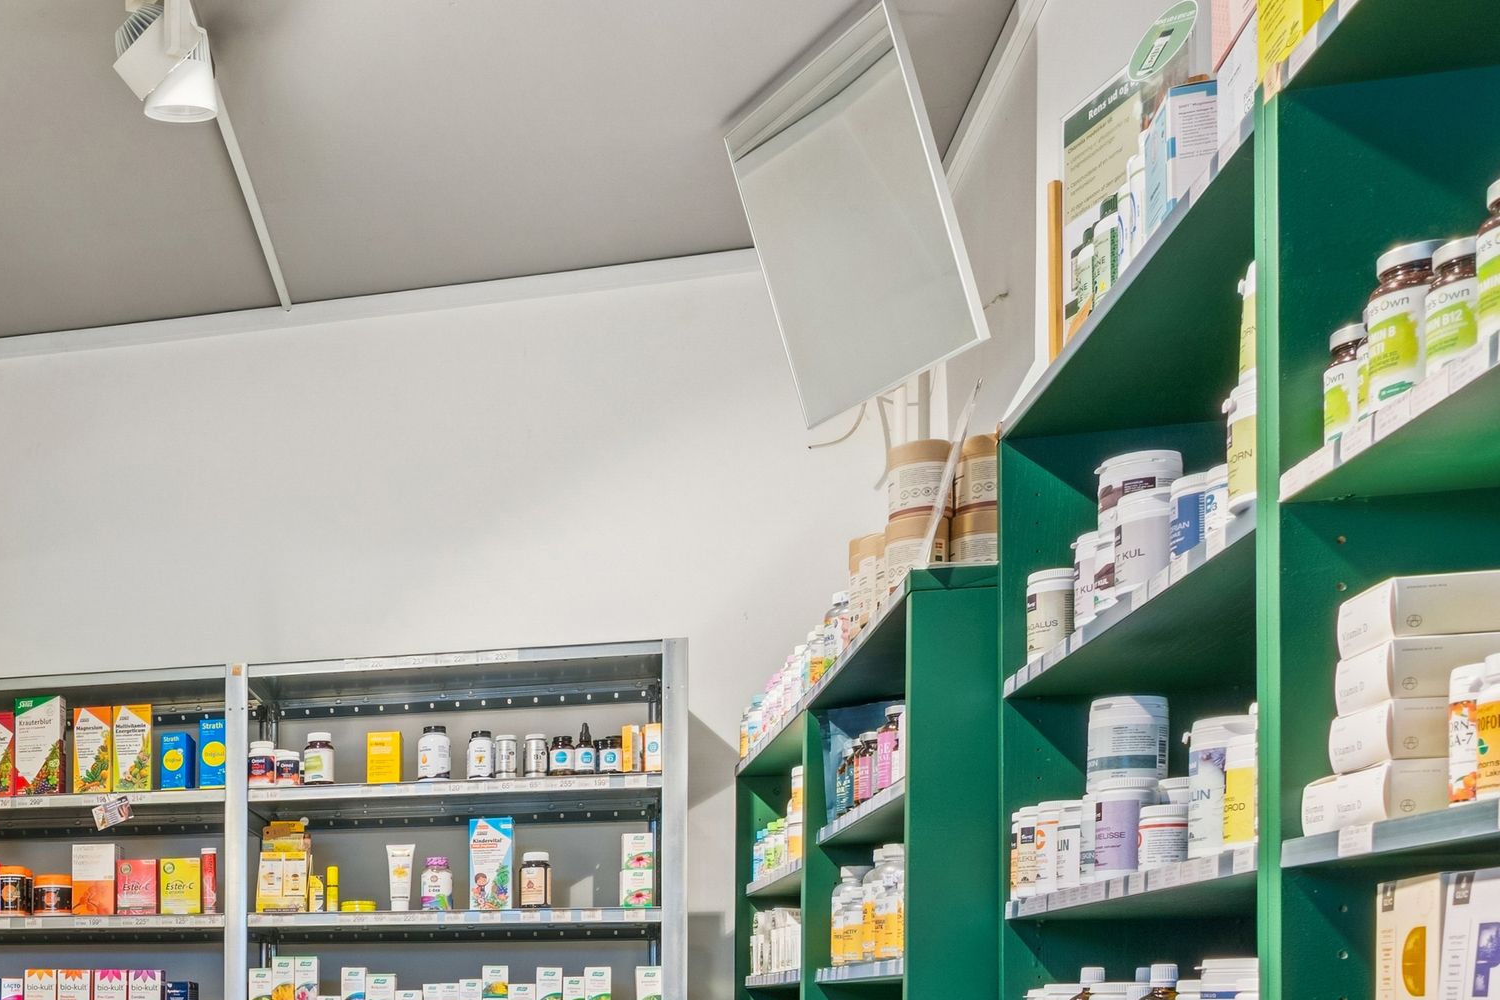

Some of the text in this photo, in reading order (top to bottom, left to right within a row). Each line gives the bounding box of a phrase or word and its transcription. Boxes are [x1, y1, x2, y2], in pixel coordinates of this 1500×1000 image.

[1087, 82, 1130, 120] Rens ud og
[1438, 286, 1470, 305] Own
[1380, 294, 1410, 312] Own
[1440, 309, 1464, 324] B12
[1122, 548, 1146, 560] KUL
[201, 721, 224, 730] Strath
[122, 882, 150, 891] Ester-C
[165, 882, 195, 891] Ester-C
[26, 982, 53, 991] bio-kult
[59, 983, 88, 991] bio-kult
[97, 983, 124, 992] bio-kult
[131, 983, 158, 992] bio-kult
